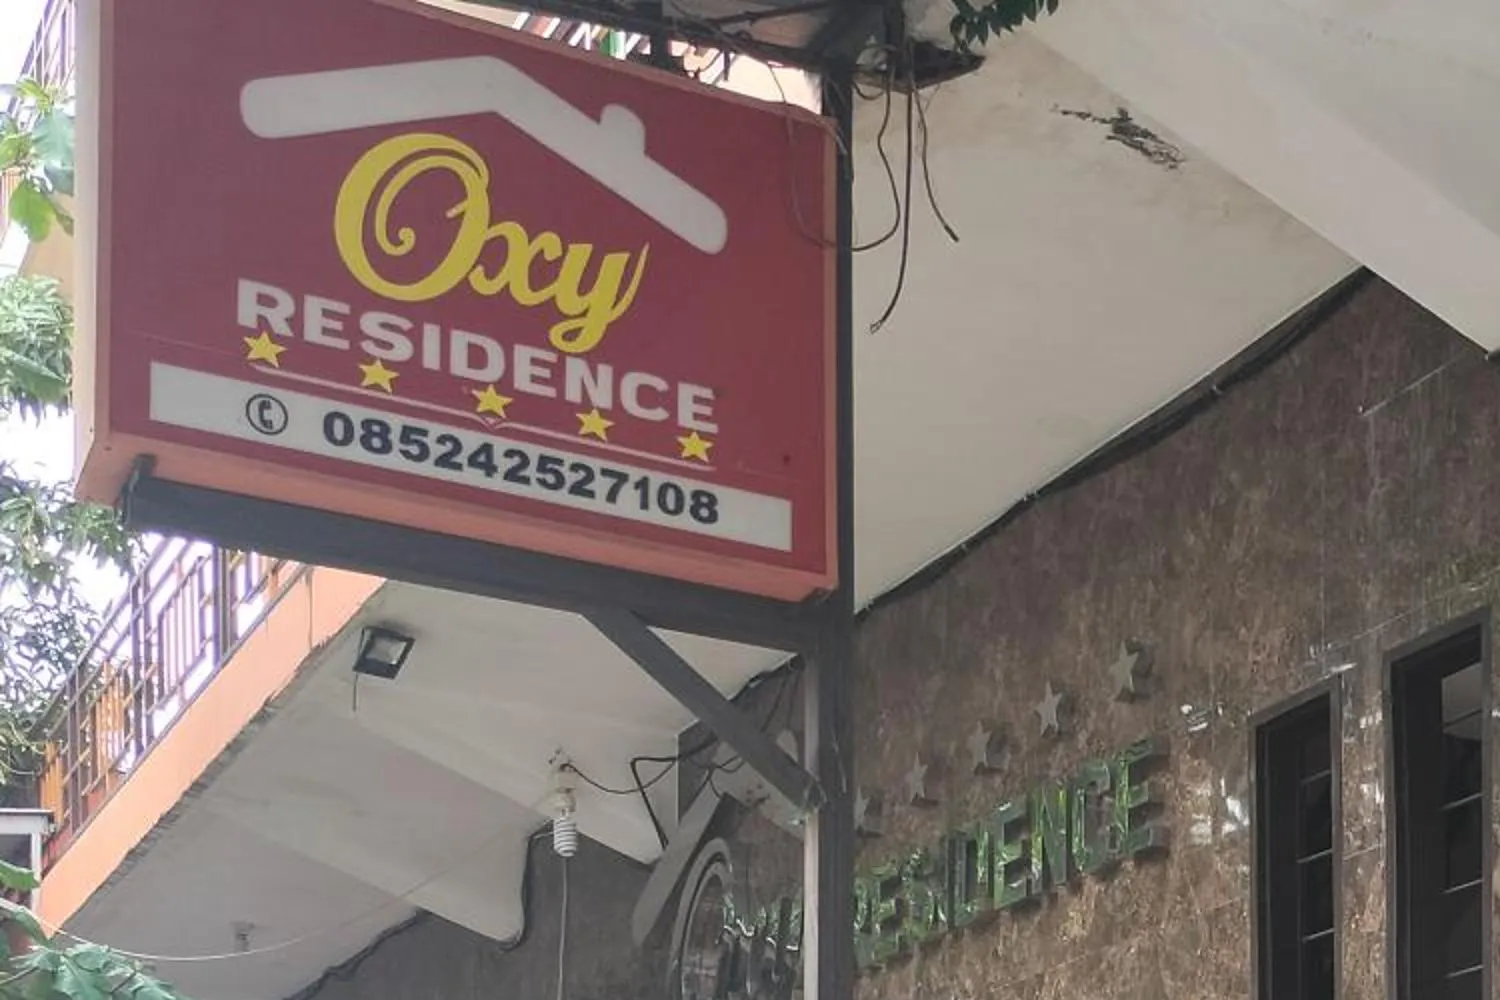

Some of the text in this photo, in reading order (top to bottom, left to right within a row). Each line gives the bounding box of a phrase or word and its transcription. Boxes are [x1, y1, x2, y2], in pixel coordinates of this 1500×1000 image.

[334, 133, 649, 352] Oxy
[237, 278, 720, 435] RESIDENCE
[323, 410, 720, 525] 085242527108
[853, 738, 1153, 968] ESIDENCE
